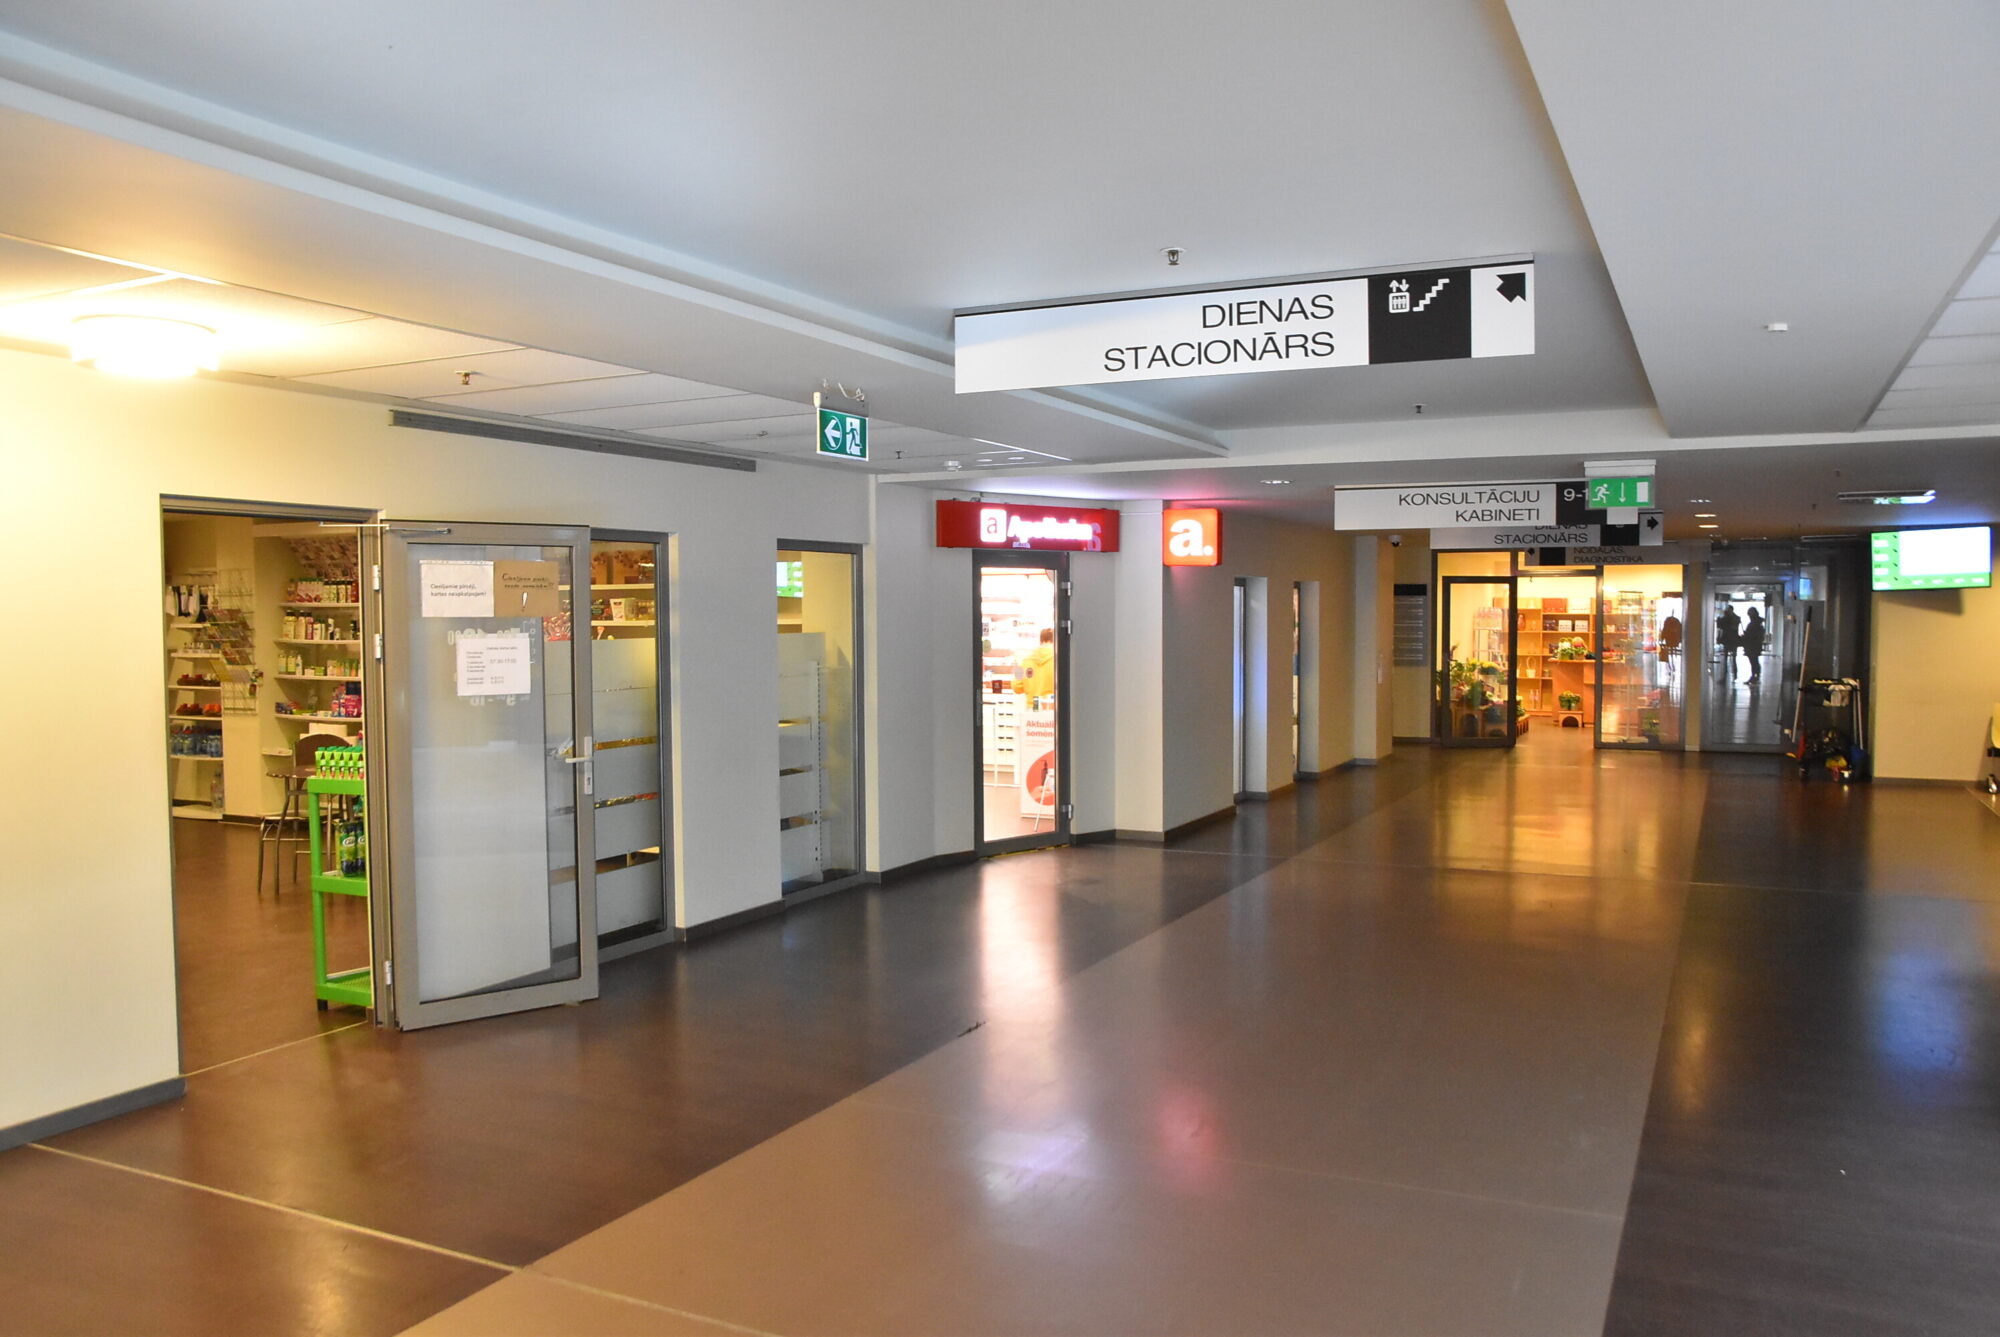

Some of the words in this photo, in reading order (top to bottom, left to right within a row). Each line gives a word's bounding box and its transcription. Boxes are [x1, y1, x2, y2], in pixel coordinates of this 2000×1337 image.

[1202, 294, 1334, 329] DIENAS
[1104, 331, 1335, 372] STACIONĀRS
[1399, 488, 1540, 506] KONSULTĀCIJU
[1456, 508, 1540, 522] KABINETI
[1494, 532, 1588, 545] STACIONĀRS
[1574, 555, 1644, 563] DIAGNOSTIKA
